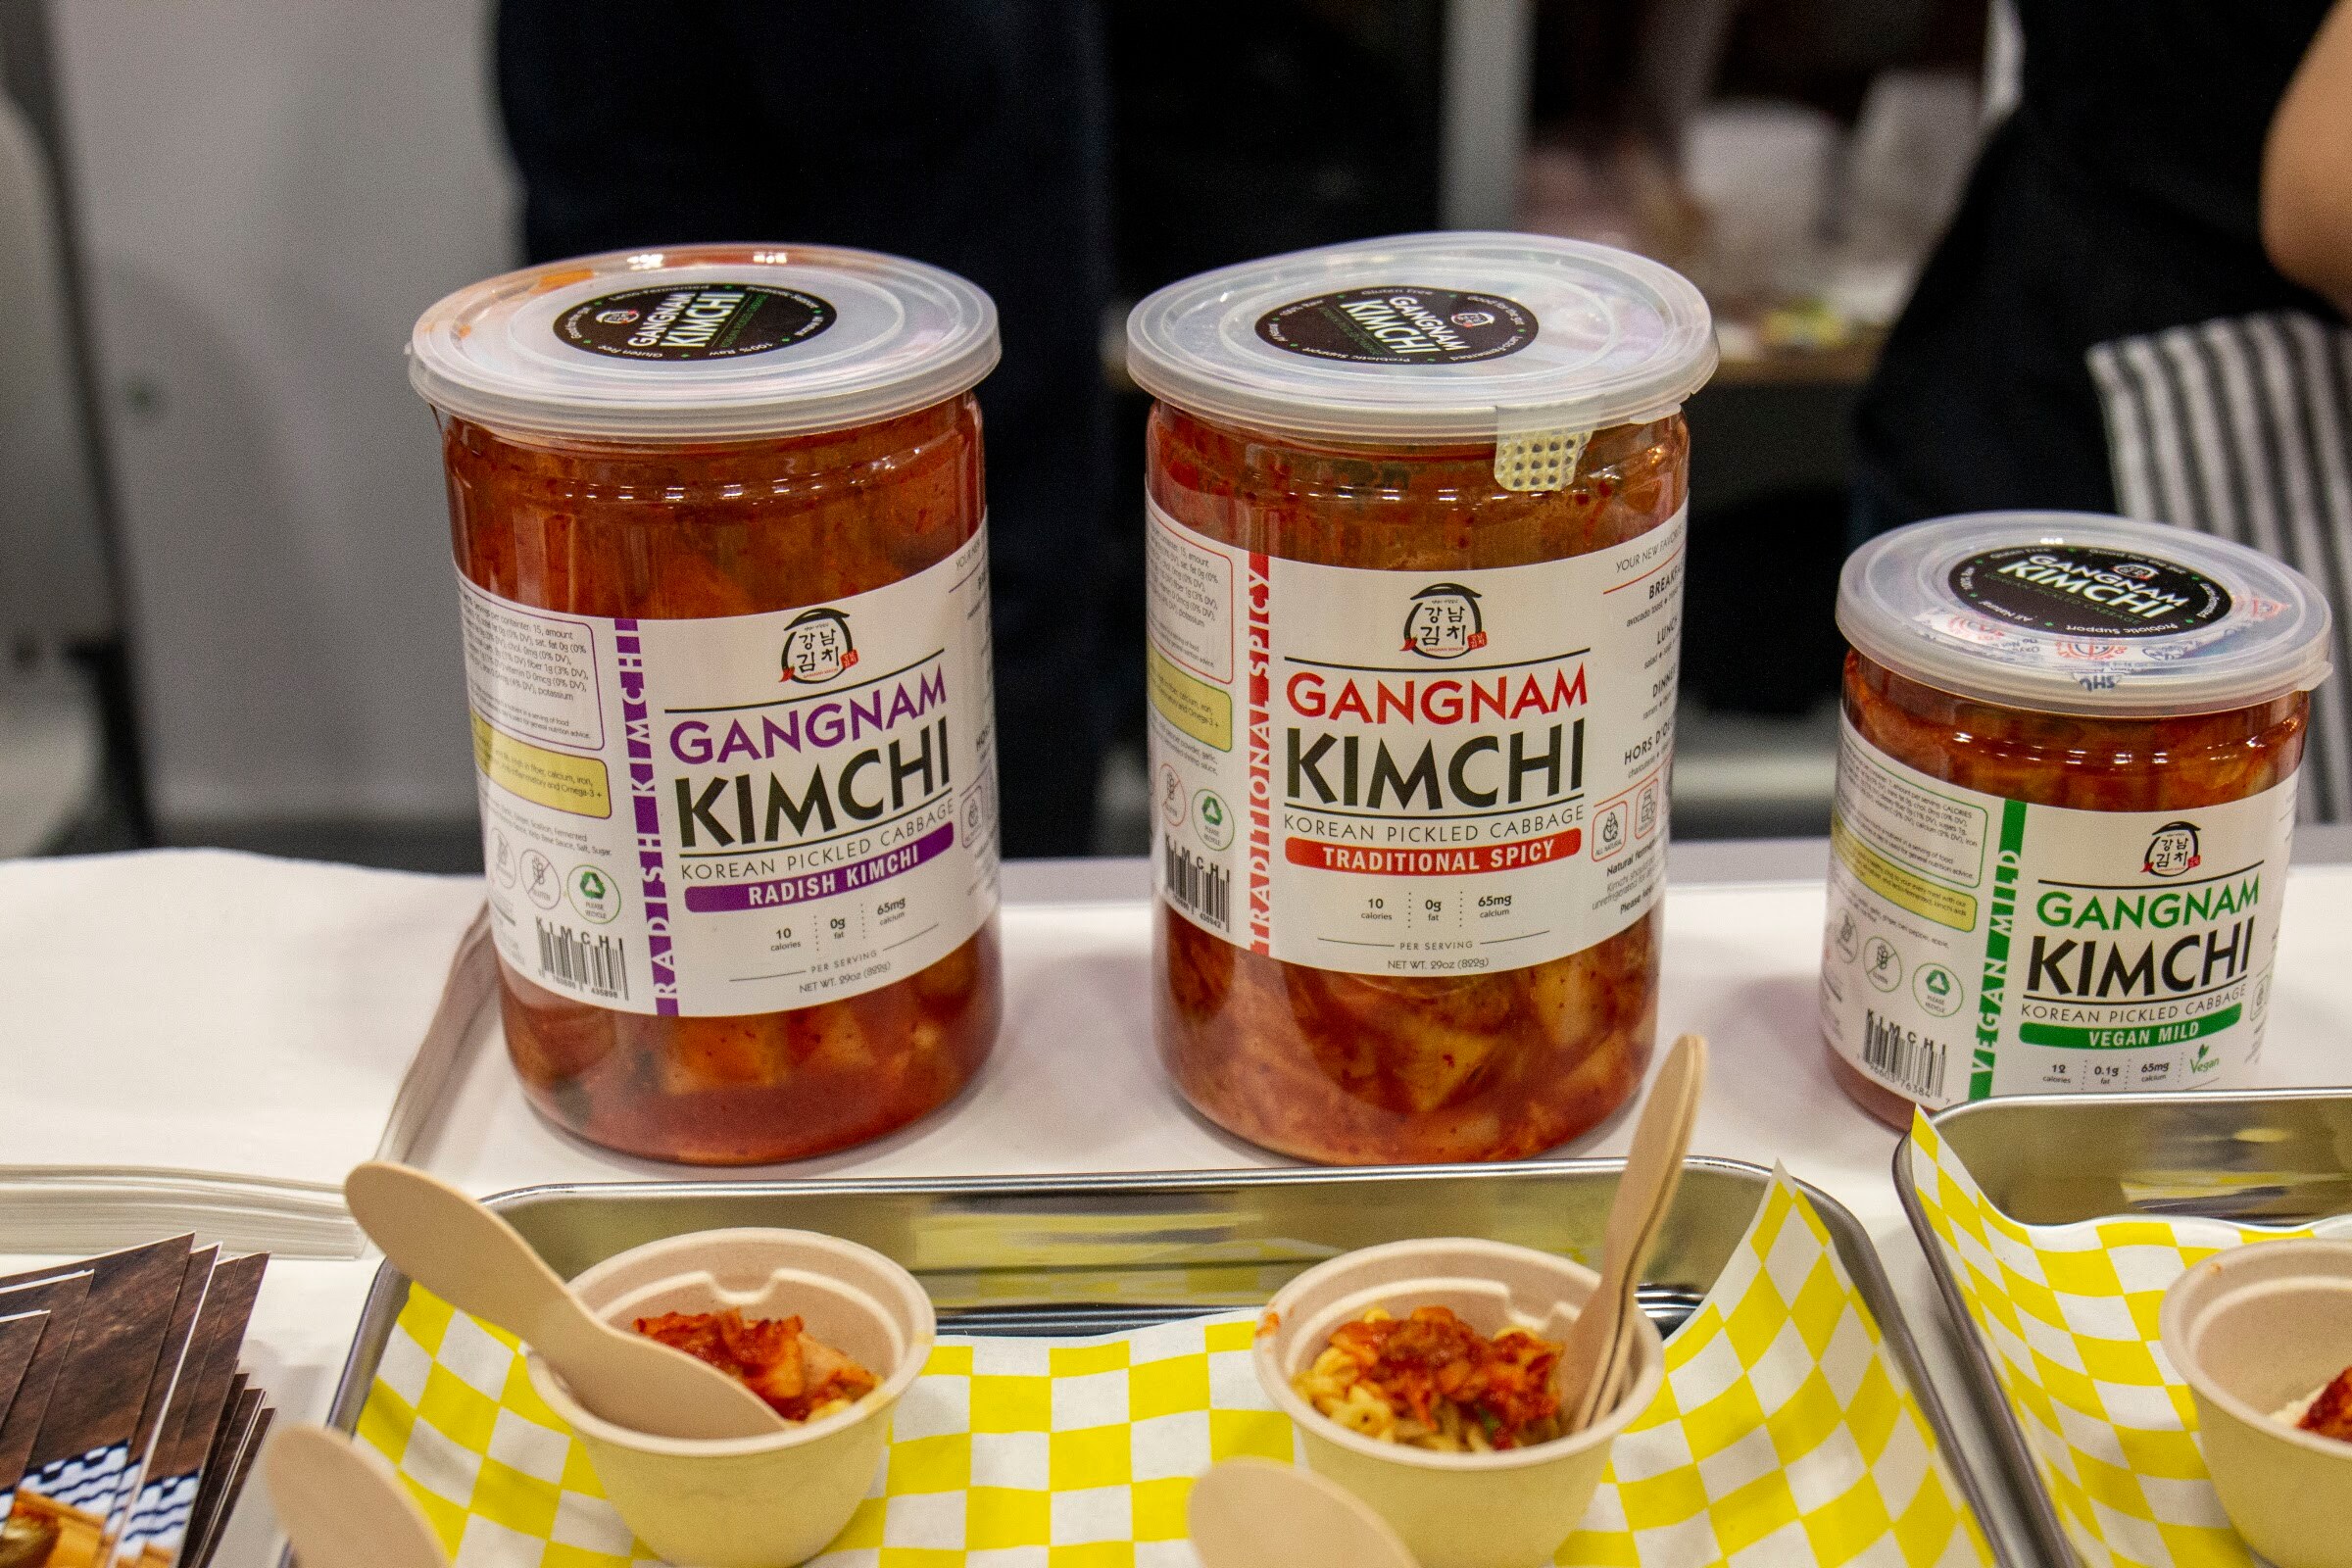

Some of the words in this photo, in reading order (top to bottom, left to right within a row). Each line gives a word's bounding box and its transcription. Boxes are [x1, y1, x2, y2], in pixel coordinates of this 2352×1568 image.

[628, 292, 698, 347] GANGNAM
[660, 292, 745, 348] KIMCHI
[1340, 300, 1442, 354] KIMCHI
[1389, 296, 1471, 351] GANGNAM
[1616, 553, 1640, 574] YOUR
[1642, 544, 1659, 563] NEW
[1996, 561, 2177, 618] KIMCHI
[2029, 555, 2189, 607] GANGNAM
[1249, 567, 1270, 679] SPICY
[1425, 606, 1466, 624] 강남
[545, 628, 573, 640] amount
[569, 644, 587, 655] (0%
[799, 627, 837, 650] 강남
[1420, 624, 1467, 647] 김치
[554, 665, 568, 677] (3%
[571, 668, 589, 681] DV),
[797, 646, 841, 673] 김치
[538, 688, 573, 701] potassium
[569, 678, 587, 693] DV),
[1286, 662, 1588, 725] GANGNAM
[615, 629, 657, 798] KIMCHI
[669, 662, 947, 764] GANGNAM
[1287, 717, 1585, 810] KIMCHI
[1625, 737, 1652, 765] HORS
[548, 770, 575, 784] calcium,
[674, 715, 952, 850] KIMCHI
[682, 859, 775, 880] KOREAN
[787, 838, 870, 871] PICKLED
[881, 798, 955, 847] CABBAGE
[1249, 699, 1270, 948] TRADITIONAL
[1284, 813, 1374, 841] KOREAN
[1388, 824, 1478, 843] PICKLED
[1491, 805, 1584, 838] CABBAGE
[1322, 846, 1480, 872] TRADITIONAL
[1491, 839, 1555, 868] SPICY
[2156, 851, 2188, 867] 김치
[2161, 837, 2189, 852] 강남
[749, 874, 836, 906] RADISH
[847, 845, 918, 887] KIMCHI
[1607, 854, 1634, 877] Natural
[1367, 899, 1384, 909] 10
[1425, 900, 1442, 912] 0g
[1478, 895, 1512, 908] 65mg
[1988, 849, 2021, 937] MILD
[2036, 873, 2260, 931] GANGNAM
[636, 832, 678, 1000] RADISH
[776, 927, 792, 940] 10
[830, 918, 846, 931] 0g
[877, 897, 906, 916] 65mg
[1360, 911, 1393, 921] calories
[1428, 912, 1439, 921] fat
[1480, 907, 1510, 919] calcium
[770, 941, 802, 952] calories
[834, 931, 845, 940] fat
[879, 910, 905, 927] calcium
[1399, 942, 1419, 951] PER
[1425, 941, 1473, 950] SERVING
[810, 963, 829, 974] PER
[834, 951, 877, 969] SERVING
[1388, 959, 1406, 969] NET
[1410, 959, 1427, 969] WT.
[1431, 960, 1454, 970] 29oz
[1457, 957, 1489, 970] (822g)
[2027, 914, 2255, 998] KIMCHI
[799, 982, 817, 994] NET
[820, 979, 837, 991] WT.
[839, 972, 861, 986] 29oz
[1971, 956, 2008, 1073] VEGAN
[2021, 1004, 2099, 1023] KOREAN
[2110, 1005, 2179, 1023] PICKLED
[2185, 983, 2246, 1015] CABBAGE
[2088, 1029, 2150, 1047] VEGAN
[2158, 1021, 2199, 1043] MILD
[2042, 1075, 2071, 1085] calories
[2141, 1074, 2167, 1083] calcium
[2094, 1065, 2119, 1077] 0.1g
[2140, 1061, 2170, 1074] 65mg
[2190, 1056, 2220, 1074] Vegan
